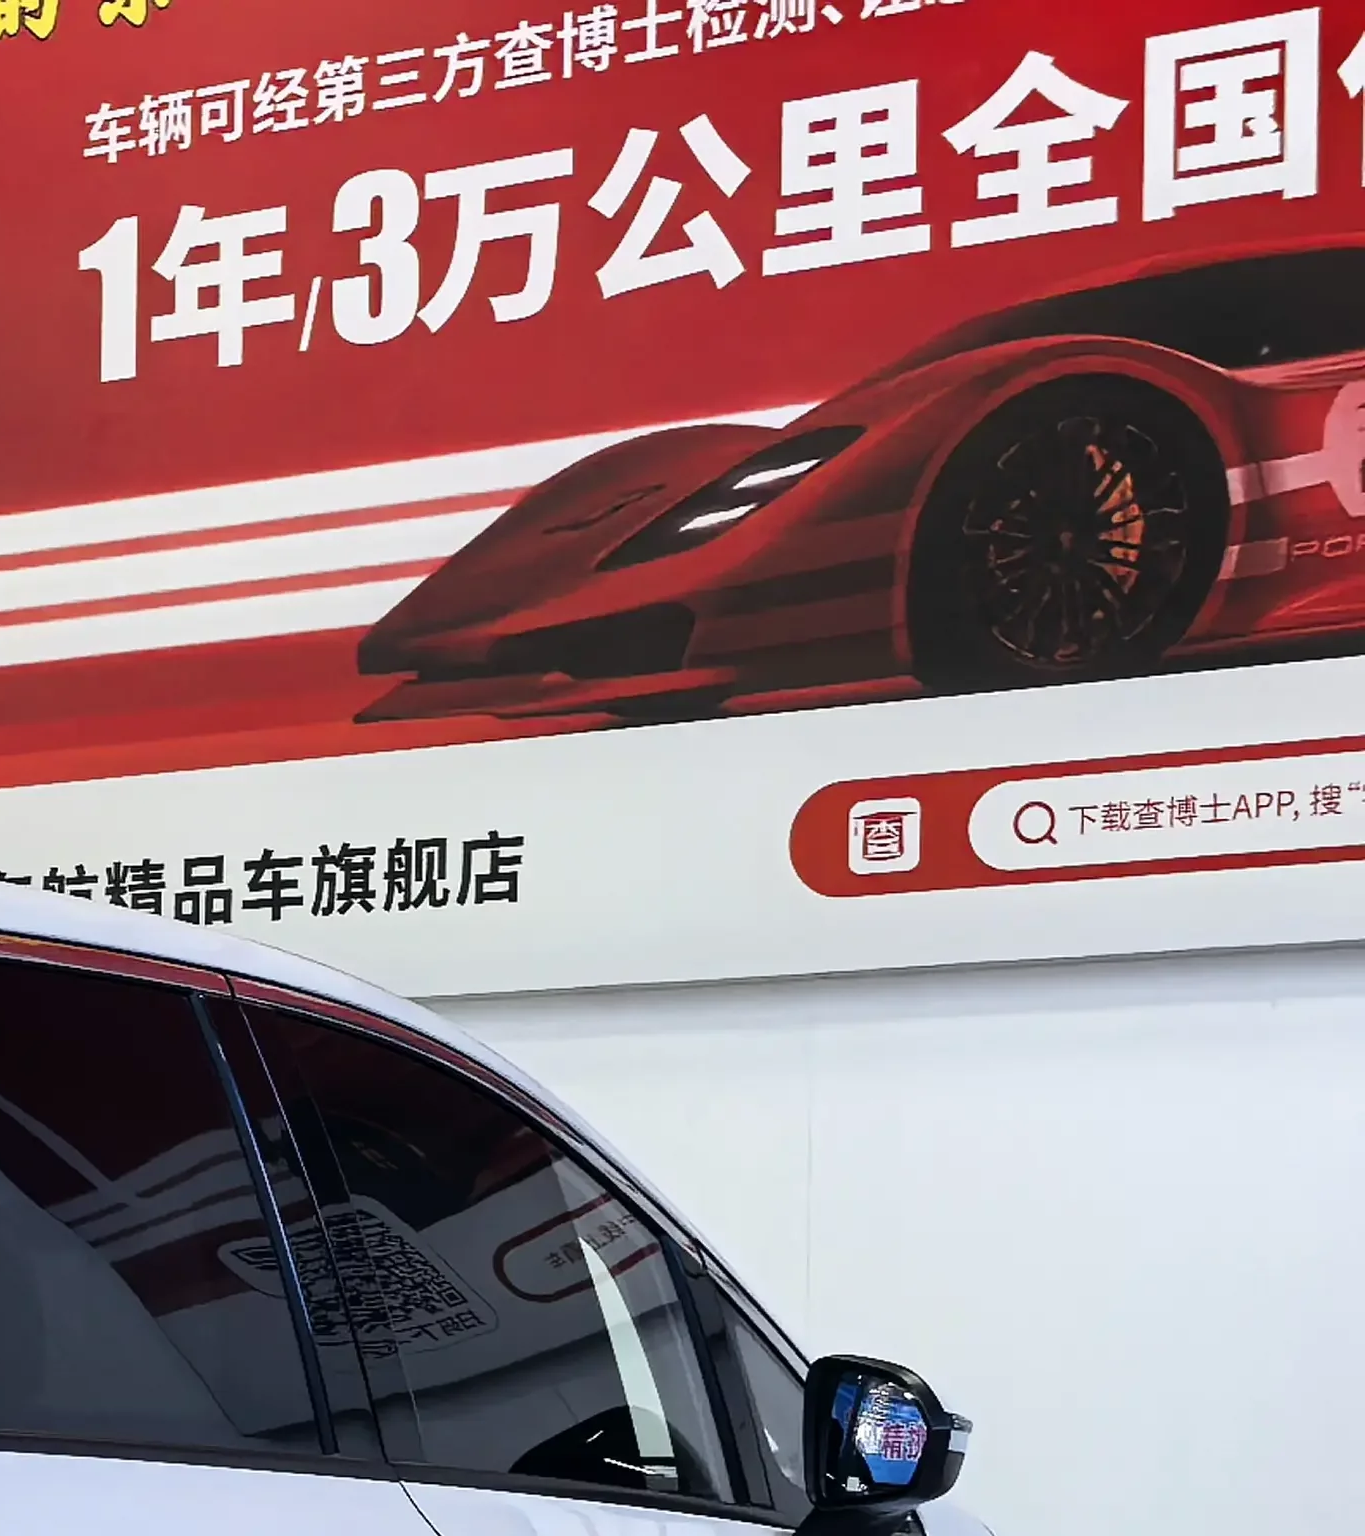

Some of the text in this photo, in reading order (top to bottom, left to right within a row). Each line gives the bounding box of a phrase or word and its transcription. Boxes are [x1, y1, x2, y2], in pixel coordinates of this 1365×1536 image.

[83, 0, 966, 164] 车辆可经第三方查博士检测、
[78, 6, 1365, 384] 1年/3万公里全国
[1068, 780, 1365, 836] 下载查博士APP，搜“
